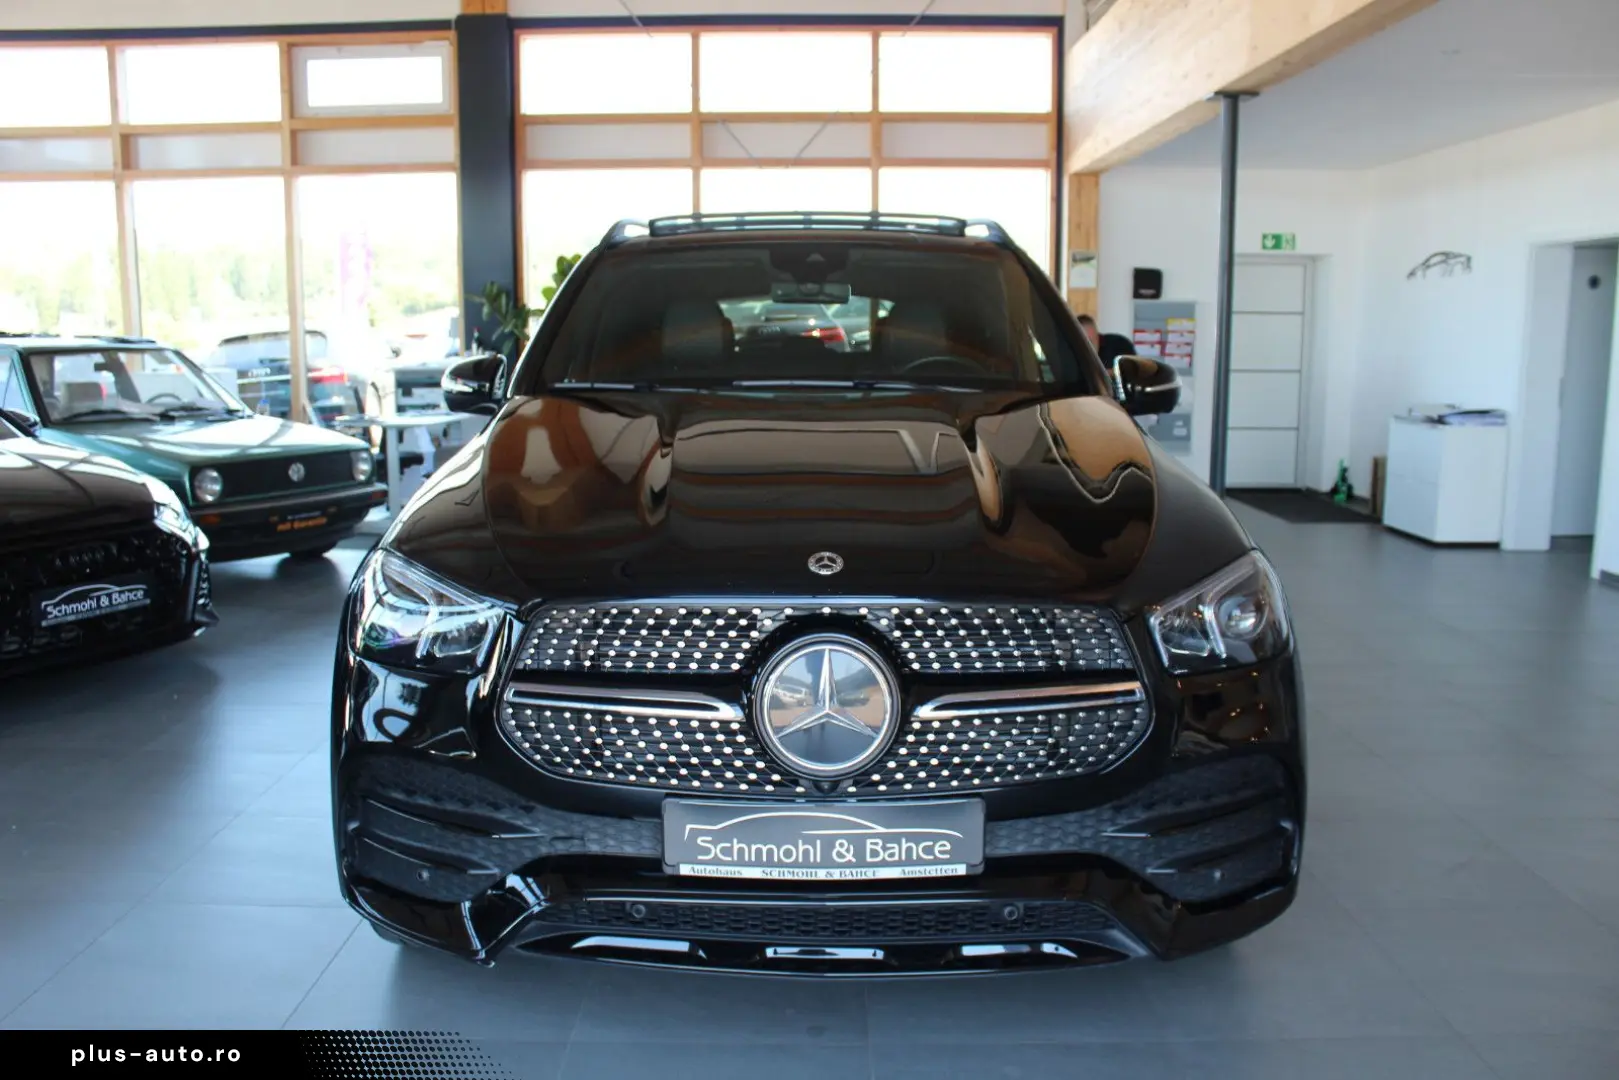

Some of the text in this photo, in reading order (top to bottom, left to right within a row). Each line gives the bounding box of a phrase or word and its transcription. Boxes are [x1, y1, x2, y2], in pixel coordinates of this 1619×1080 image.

[46, 597, 97, 619] Schmohl
[100, 595, 109, 607] &
[112, 589, 144, 604] Bahce
[696, 836, 951, 863] Schmohl & Bahce
[688, 866, 743, 877] Autohaus
[761, 869, 821, 879] SCHMOHL
[899, 867, 958, 877] Amstetten
